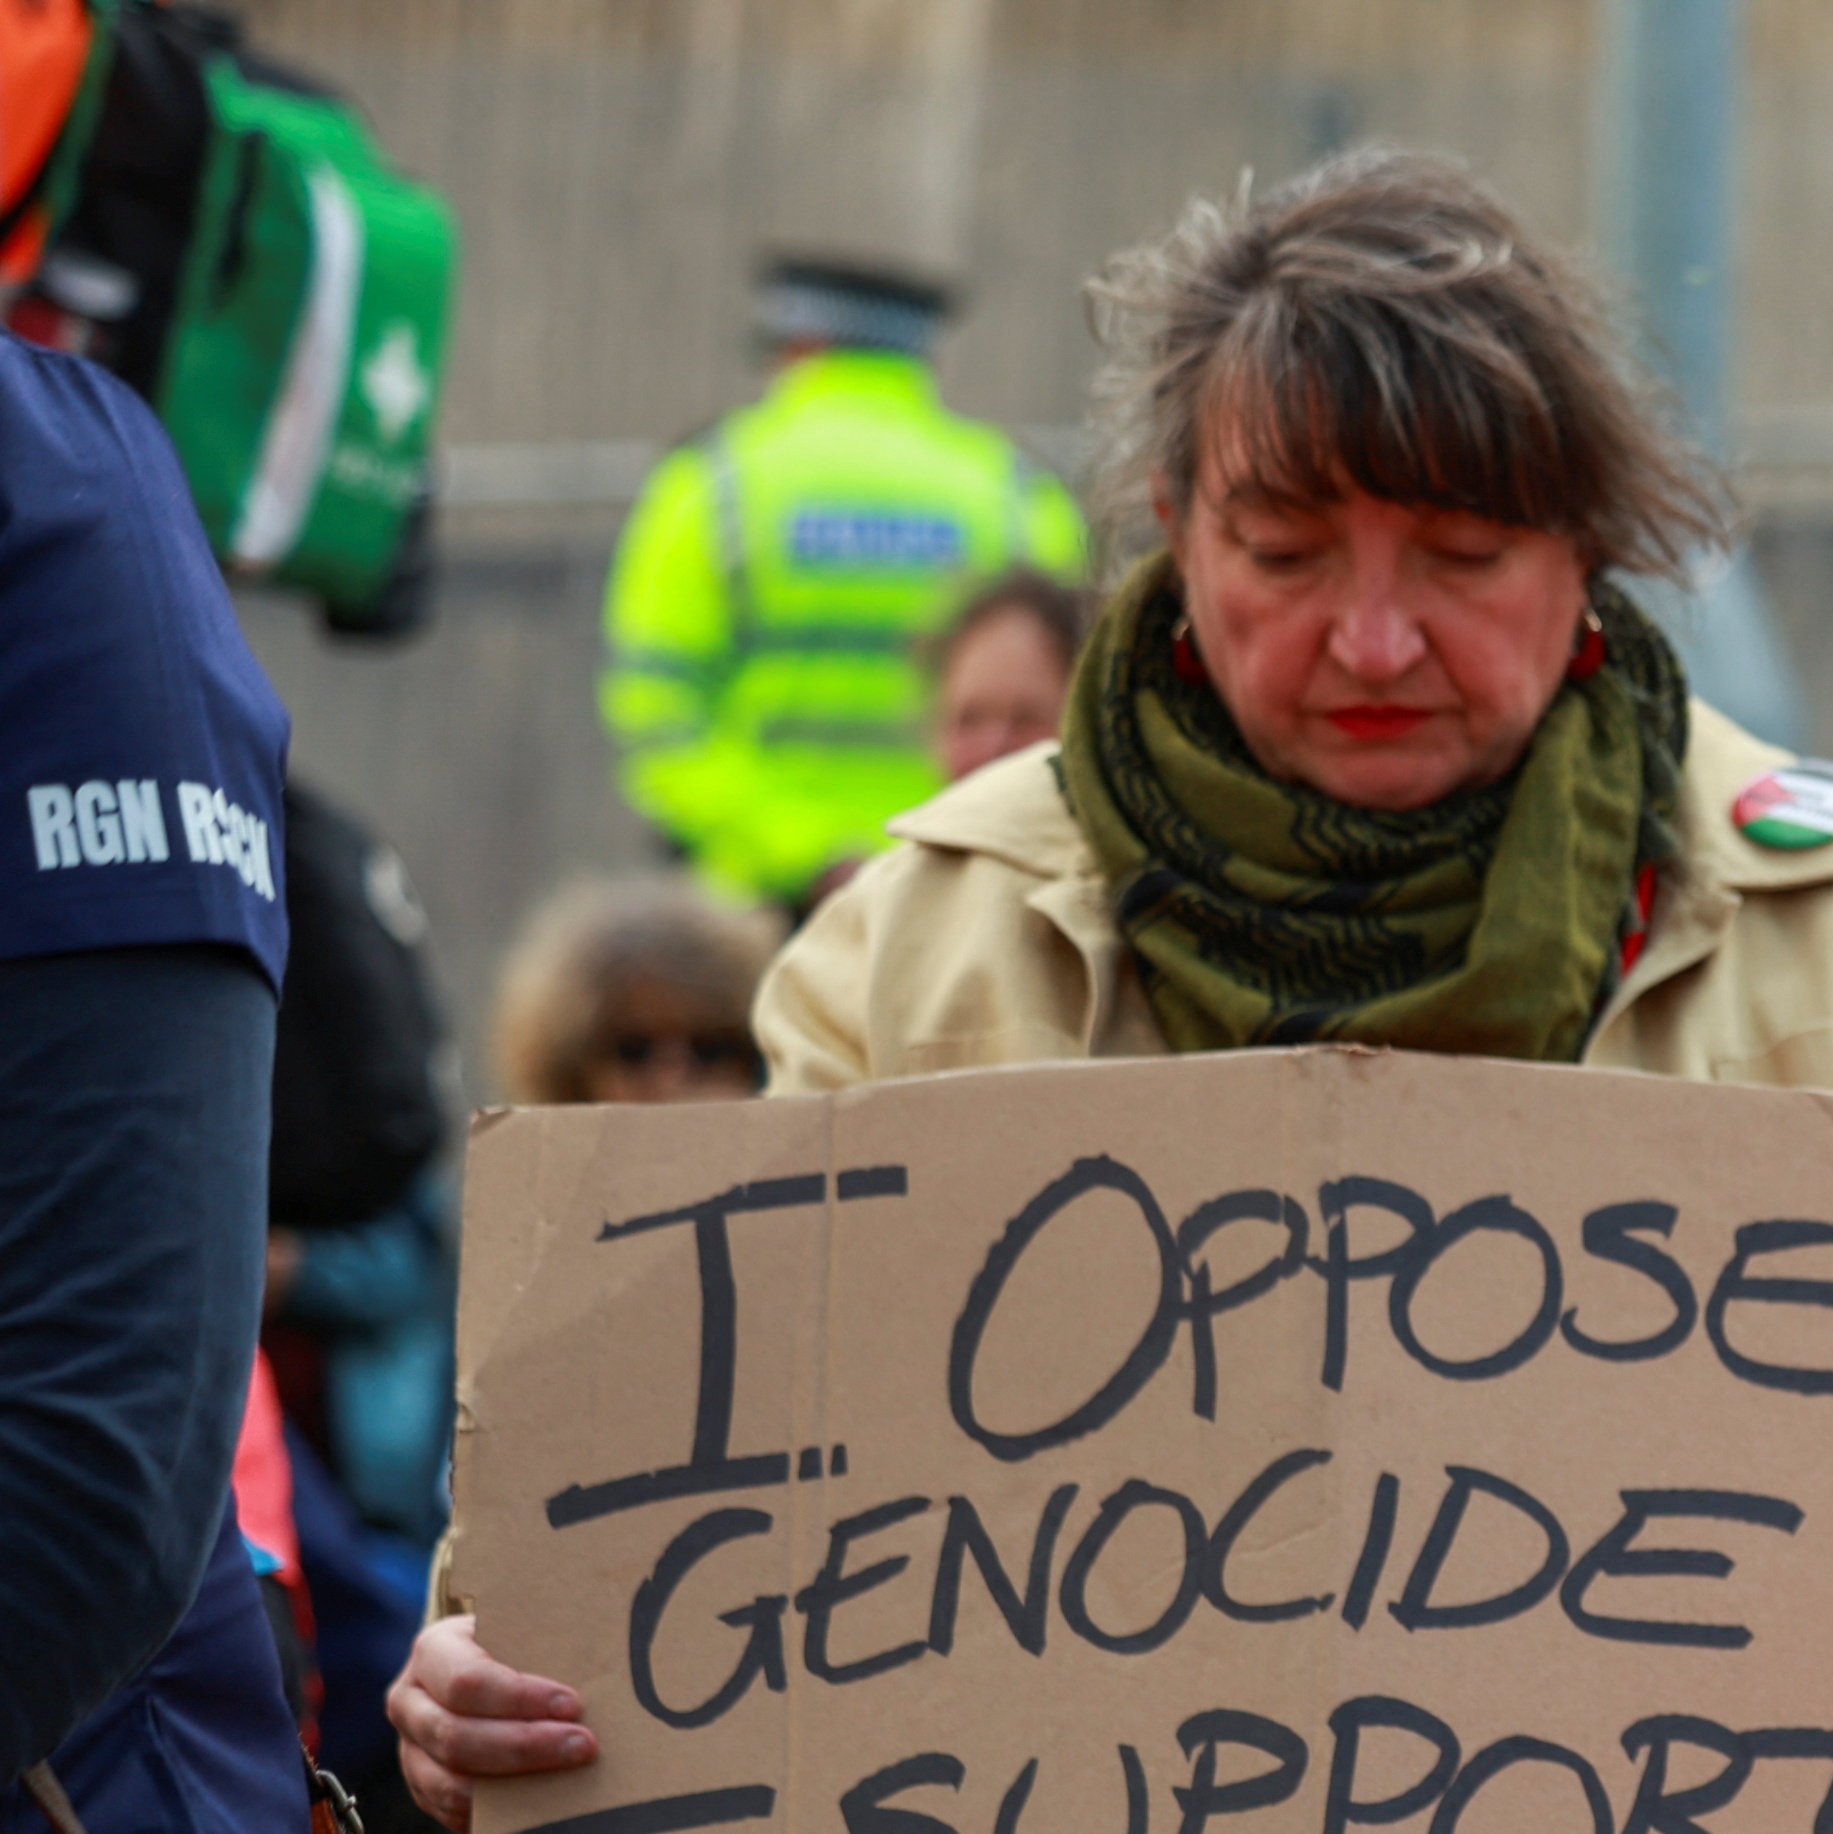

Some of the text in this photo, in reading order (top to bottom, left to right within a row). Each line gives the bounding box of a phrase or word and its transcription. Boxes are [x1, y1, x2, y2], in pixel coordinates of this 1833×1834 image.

[27, 779, 170, 871] RGN
[545, 1164, 909, 1530] I
[628, 1448, 1806, 1731] GENOCIDE
